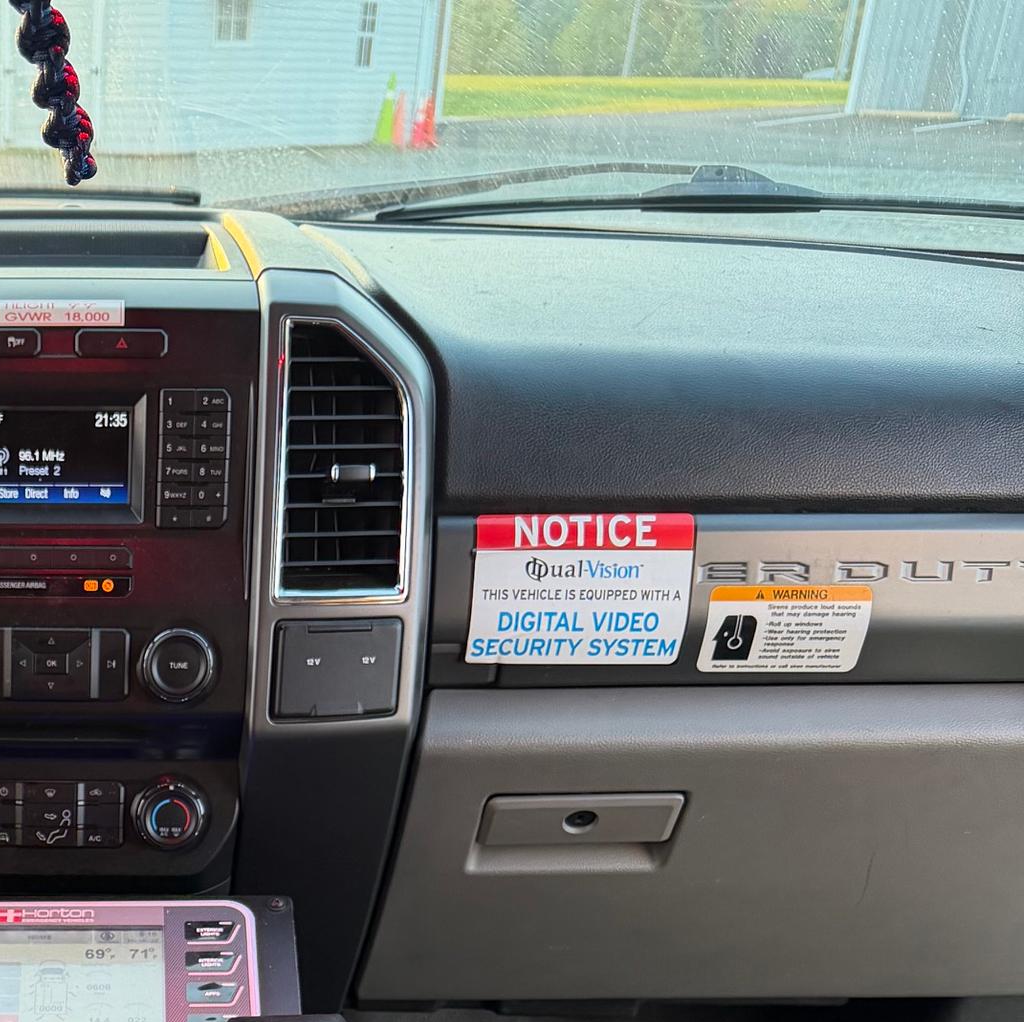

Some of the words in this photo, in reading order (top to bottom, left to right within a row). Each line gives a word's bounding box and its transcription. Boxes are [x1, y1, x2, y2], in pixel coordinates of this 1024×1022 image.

[5, 312, 52, 321] GVWR
[202, 397, 208, 405] 2
[95, 413, 128, 428] 21:35
[167, 444, 172, 452] 5
[42, 451, 65, 462] MHz
[19, 466, 49, 476] Preset
[53, 467, 61, 476] 2
[165, 467, 171, 475] 7
[199, 468, 205, 476] 8
[25, 488, 49, 499] Direct
[63, 488, 80, 499] Info
[164, 491, 170, 499] 9
[198, 491, 205, 499] 0
[514, 515, 657, 547] NOTICE
[834, 560, 1024, 583] DUT
[483, 589, 508, 600] THIS
[512, 589, 561, 600] VEHICLE
[565, 589, 576, 600] IS
[580, 589, 637, 601] EQUIPPED
[641, 590, 670, 601] WITH
[673, 590, 681, 601] A
[773, 590, 828, 600] WARNING
[791, 604, 818, 612] produce
[497, 612, 584, 632] DIGITAL
[593, 612, 659, 632] VIDEO
[471, 639, 583, 657] SECURITY
[588, 638, 677, 657] SYSTEM
[46, 659, 57, 667] OK
[169, 661, 188, 670] TUNE
[22, 908, 94, 918] Horton
